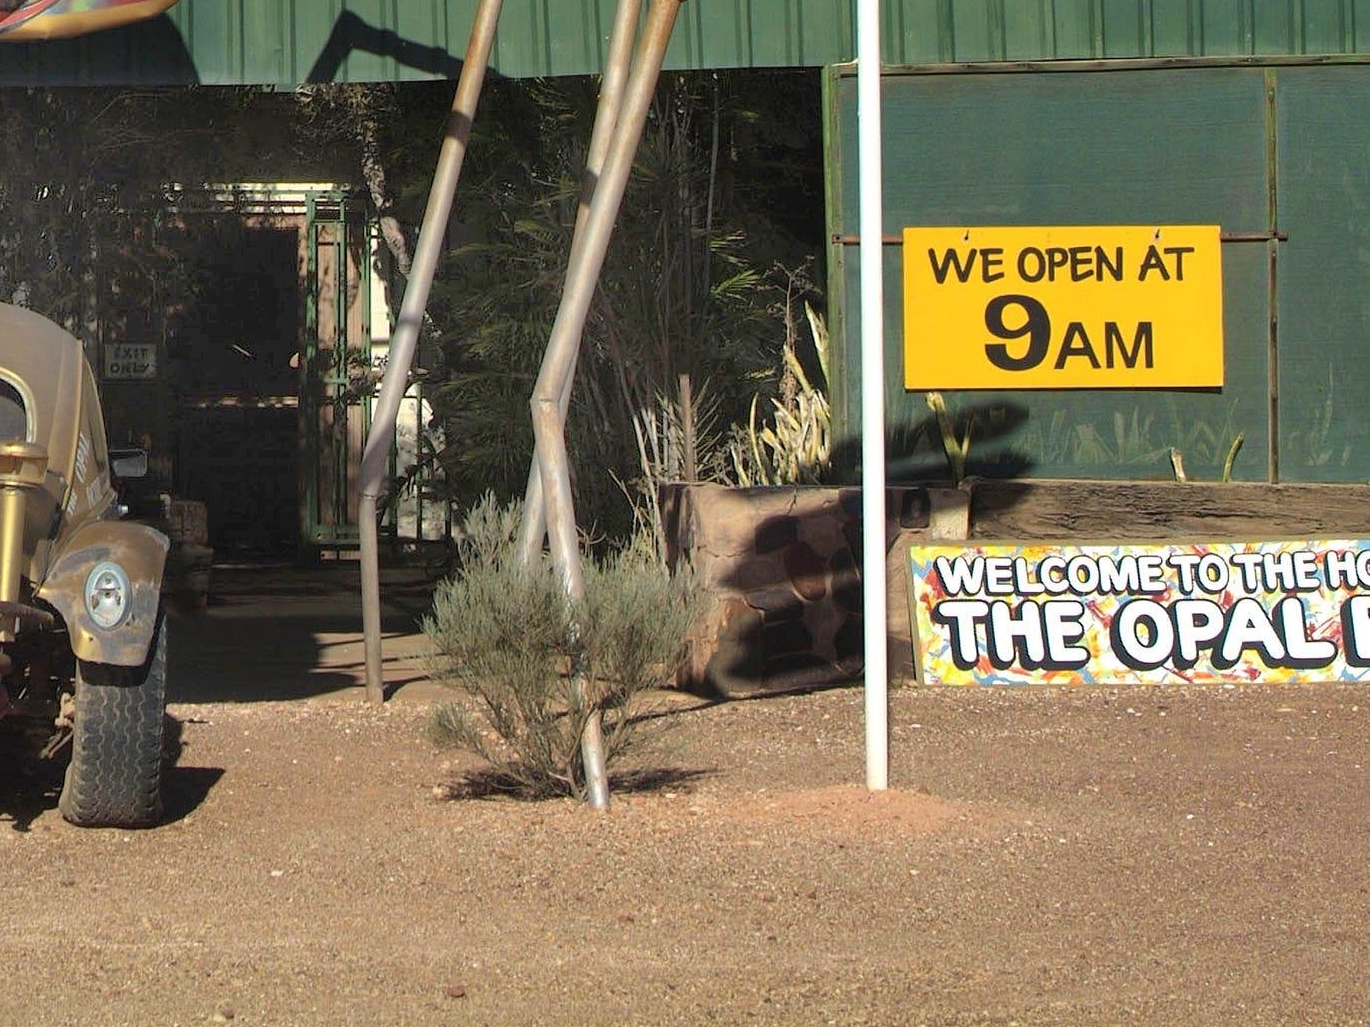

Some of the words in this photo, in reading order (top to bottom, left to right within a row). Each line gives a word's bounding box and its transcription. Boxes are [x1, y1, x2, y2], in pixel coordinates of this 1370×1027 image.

[928, 247, 1005, 285] WE
[1017, 245, 1124, 283] OPEN
[1138, 244, 1195, 282] AT
[934, 555, 1168, 597] WELCOME
[1166, 554, 1230, 596] TO
[1229, 551, 1322, 595] THE
[934, 599, 1091, 671] THE
[1109, 596, 1339, 670] OPAL
